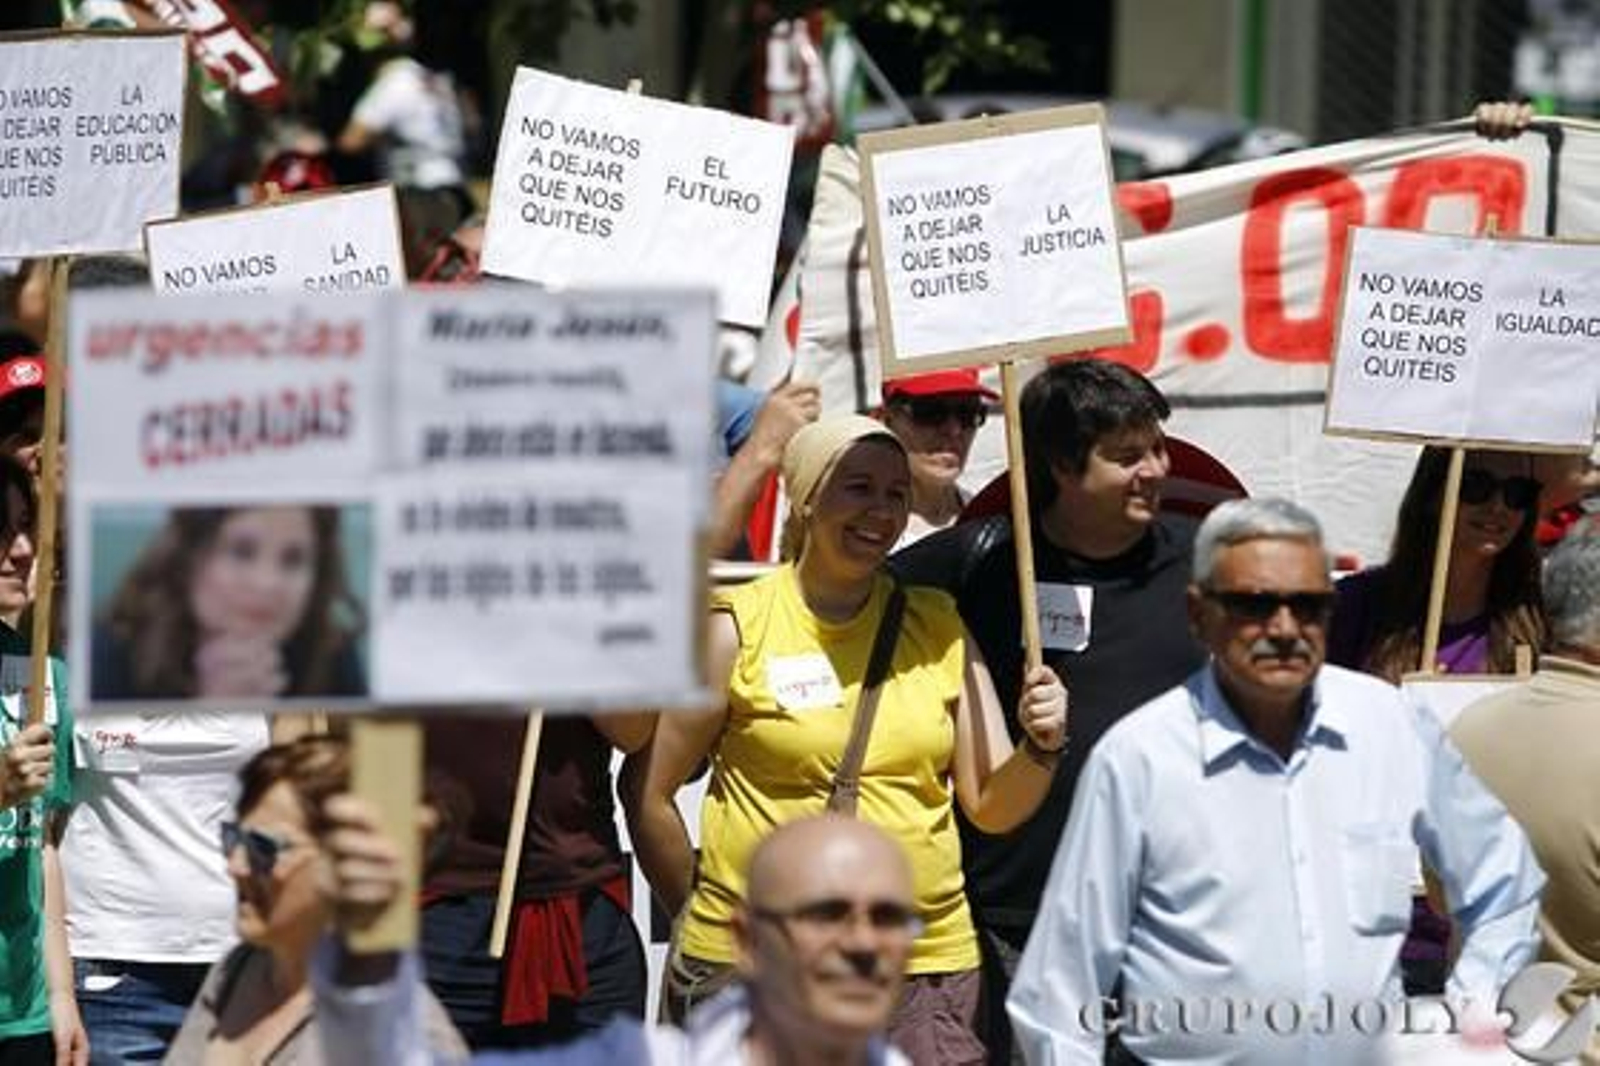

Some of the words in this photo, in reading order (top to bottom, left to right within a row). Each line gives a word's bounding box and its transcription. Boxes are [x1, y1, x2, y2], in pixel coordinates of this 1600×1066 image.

[0, 89, 8, 111] O
[11, 86, 71, 109] VAMOS
[121, 84, 143, 106] LA
[4, 115, 61, 140] DEJAR
[521, 117, 555, 141] NO
[561, 123, 641, 159] VAMOS
[0, 147, 20, 169] UE
[24, 145, 62, 169] NOS
[527, 147, 543, 167] A
[549, 150, 624, 183] DEJAR
[703, 156, 730, 180] EL
[0, 173, 57, 199] UITÉIS
[519, 174, 567, 201] QUE
[574, 184, 625, 212] NOS
[665, 175, 760, 214] FUTURO
[888, 194, 917, 217] NO
[921, 184, 992, 211] VAMOS
[521, 202, 613, 237] QUITÉIS
[902, 223, 916, 243] A
[919, 214, 983, 241] DEJAR
[1046, 203, 1071, 225] LA
[330, 242, 357, 265] LA
[1020, 227, 1106, 257] JUSTICIA
[901, 248, 943, 272] QUE
[949, 242, 991, 265] NOS
[164, 266, 197, 290] NO
[201, 255, 277, 283] VAMOS
[304, 265, 390, 295] SANIDAD
[910, 268, 989, 299] QUITÉIS
[1359, 273, 1395, 293] NO
[1401, 277, 1483, 303] VAMOS
[1538, 287, 1566, 308] LA
[1369, 302, 1385, 321] A
[1390, 303, 1466, 328] DEJAR
[1361, 328, 1411, 352] QUE
[1417, 334, 1467, 357] NOS
[1364, 355, 1456, 383] QUITÉIS
[140, 378, 356, 469] CERRADAS
